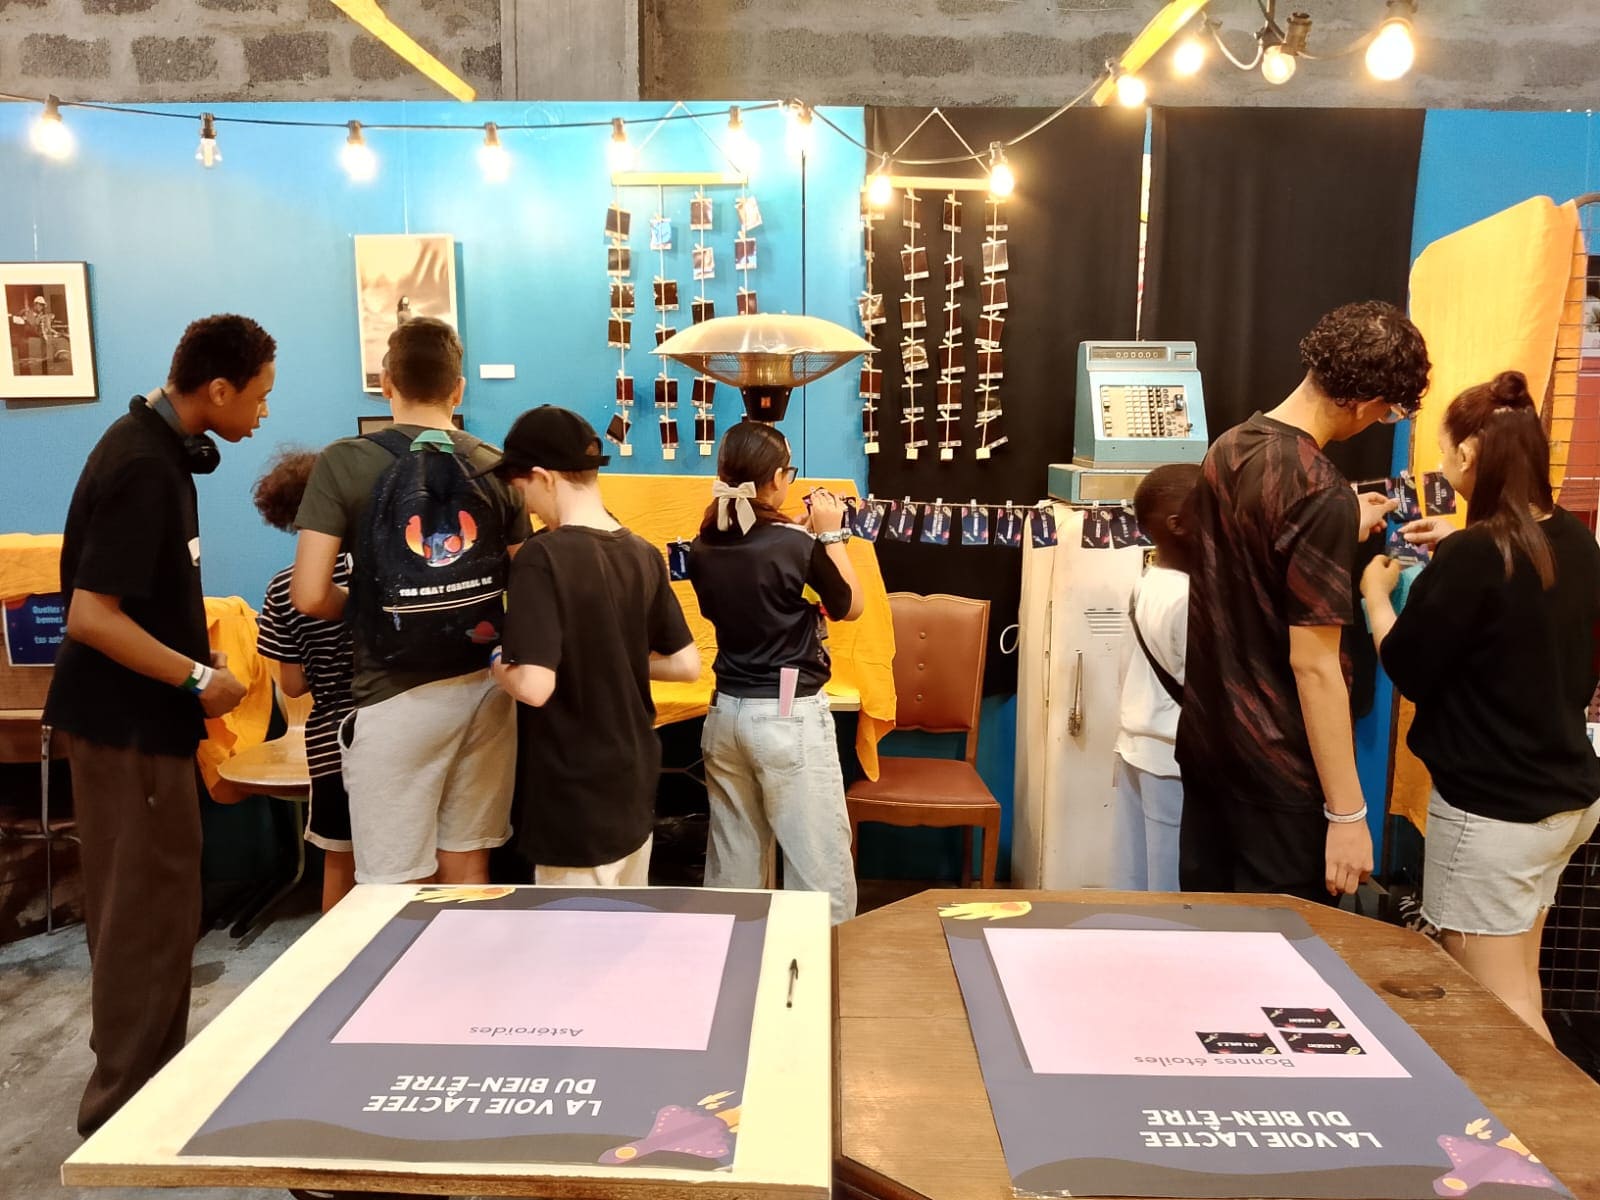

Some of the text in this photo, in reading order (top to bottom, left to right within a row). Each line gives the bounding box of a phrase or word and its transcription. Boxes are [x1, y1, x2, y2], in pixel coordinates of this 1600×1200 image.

[1133, 1056, 1296, 1068] Bonnes étoiles
[390, 1075, 596, 1097] DU BIEN-ÊTRE
[362, 1095, 602, 1116] LA VOIE LACTEE
[1142, 1110, 1352, 1131] DU BIEN-ÊTRE
[1139, 1131, 1383, 1148] LA VOIE LACTEE
